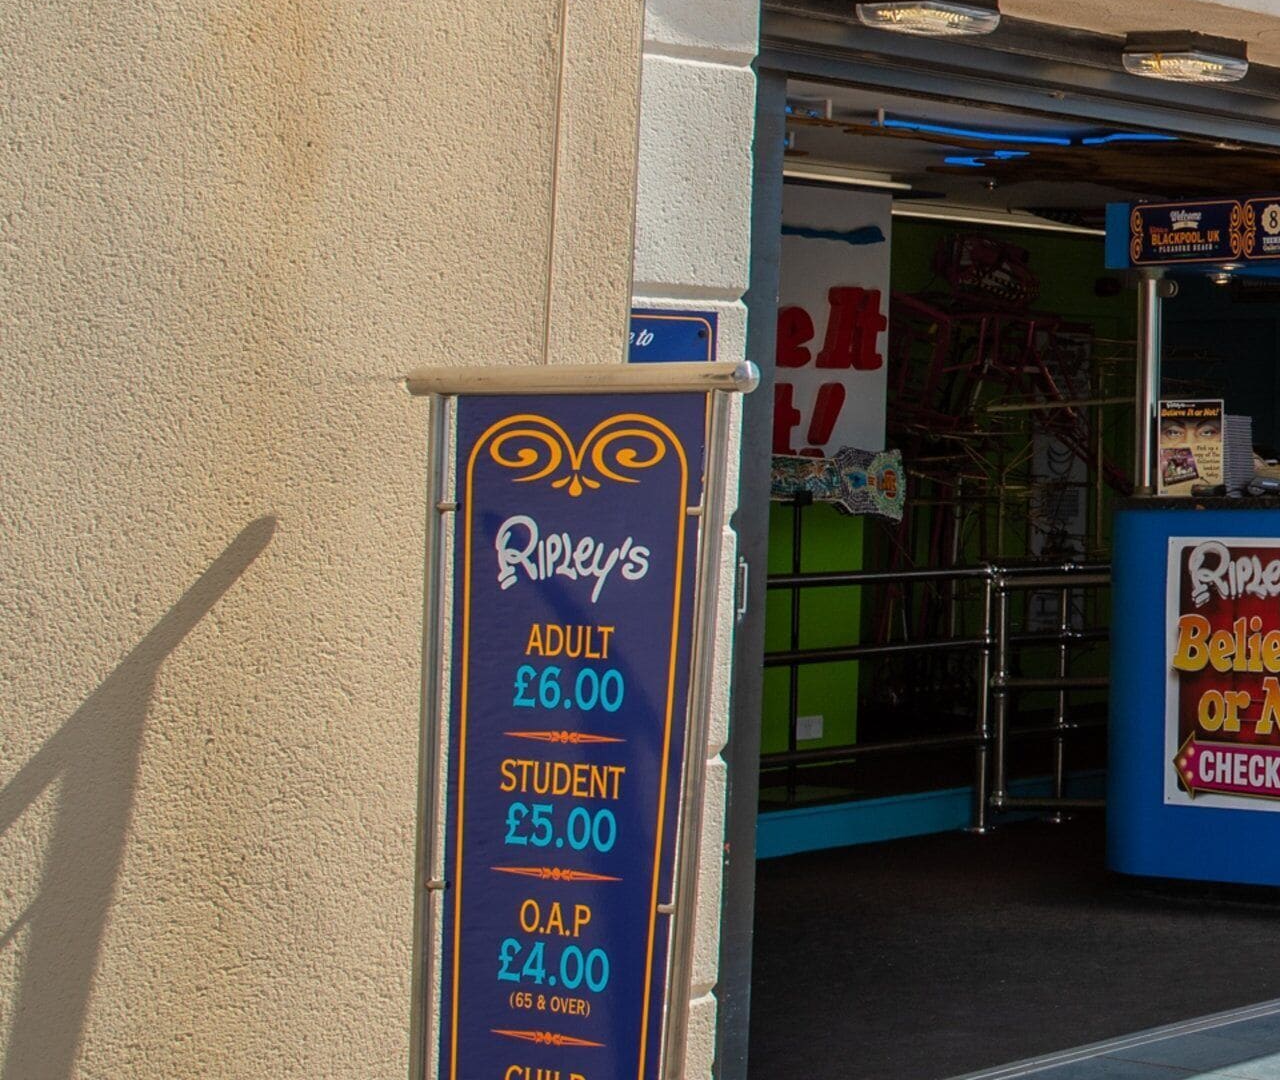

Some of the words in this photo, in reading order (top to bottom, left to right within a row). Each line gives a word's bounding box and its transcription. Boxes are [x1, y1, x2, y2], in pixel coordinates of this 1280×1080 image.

[1207, 230, 1220, 242] UK
[1270, 210, 1278, 229] 8
[636, 329, 654, 346] to
[495, 515, 650, 602] Ripley's
[525, 623, 614, 659] ADULT
[513, 665, 624, 712] £6.00
[1198, 690, 1250, 732] or
[500, 760, 625, 800] STUDENT
[504, 802, 616, 852] £5.00
[519, 899, 591, 938] O.A.P
[498, 938, 609, 993] £4.00
[510, 992, 533, 1008] (65
[537, 995, 546, 1010] &
[550, 995, 591, 1018] OVER)
